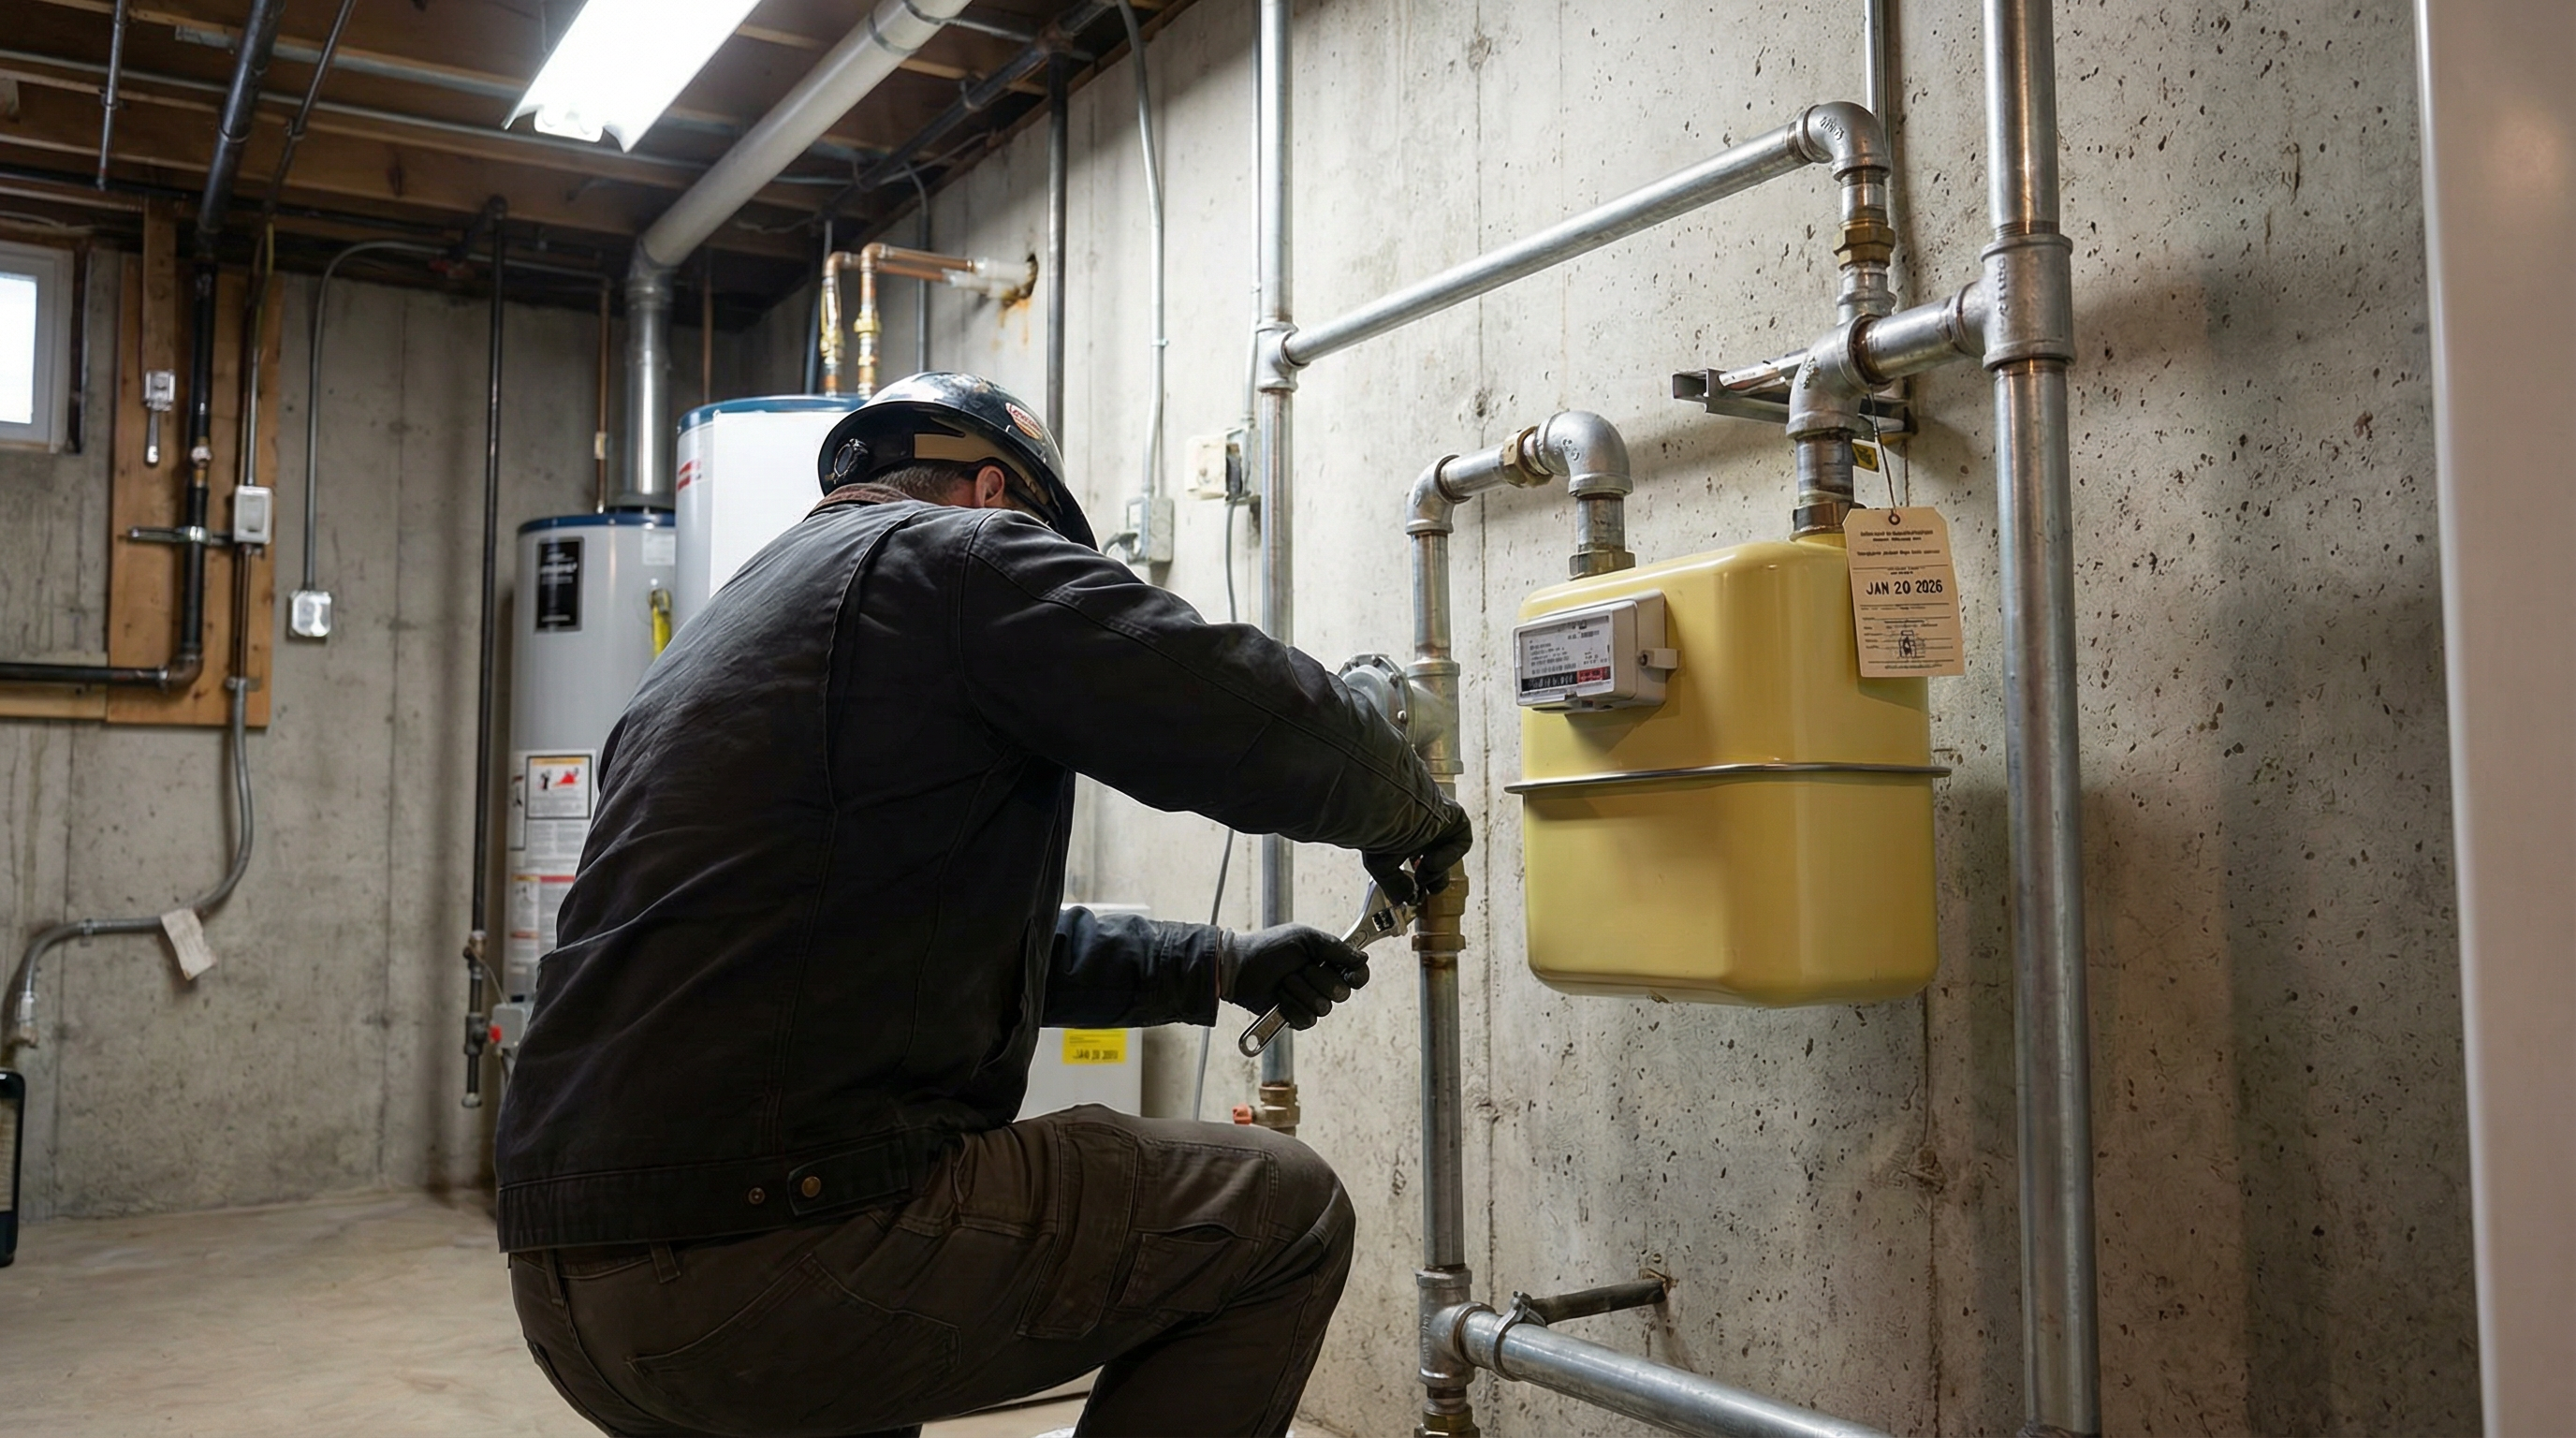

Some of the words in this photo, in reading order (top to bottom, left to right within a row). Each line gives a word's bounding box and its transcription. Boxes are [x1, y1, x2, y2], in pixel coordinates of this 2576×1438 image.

[1866, 581, 1889, 594] JAN
[1894, 580, 1910, 594] 20
[1915, 580, 1943, 594] 2026
